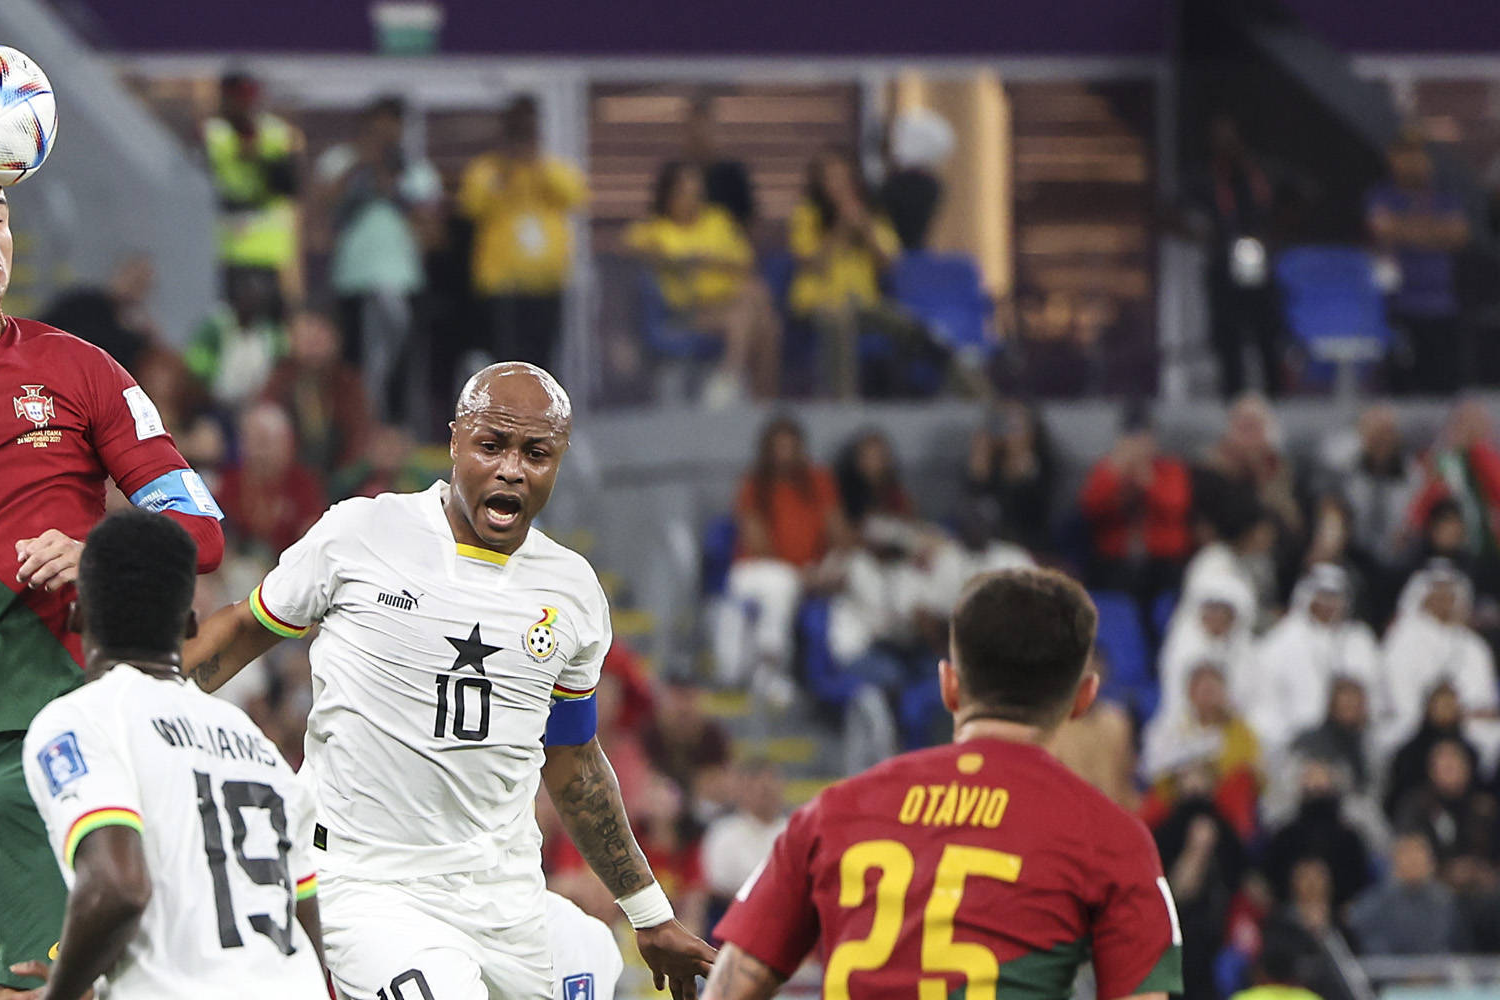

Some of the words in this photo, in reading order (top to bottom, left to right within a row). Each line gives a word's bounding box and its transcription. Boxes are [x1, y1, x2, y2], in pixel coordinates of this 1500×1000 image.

[377, 592, 413, 611] PUMA
[434, 674, 492, 741] 10
[152, 717, 276, 768] WILIAMS
[899, 781, 1009, 828] OTÁVIO
[193, 769, 296, 956] 19
